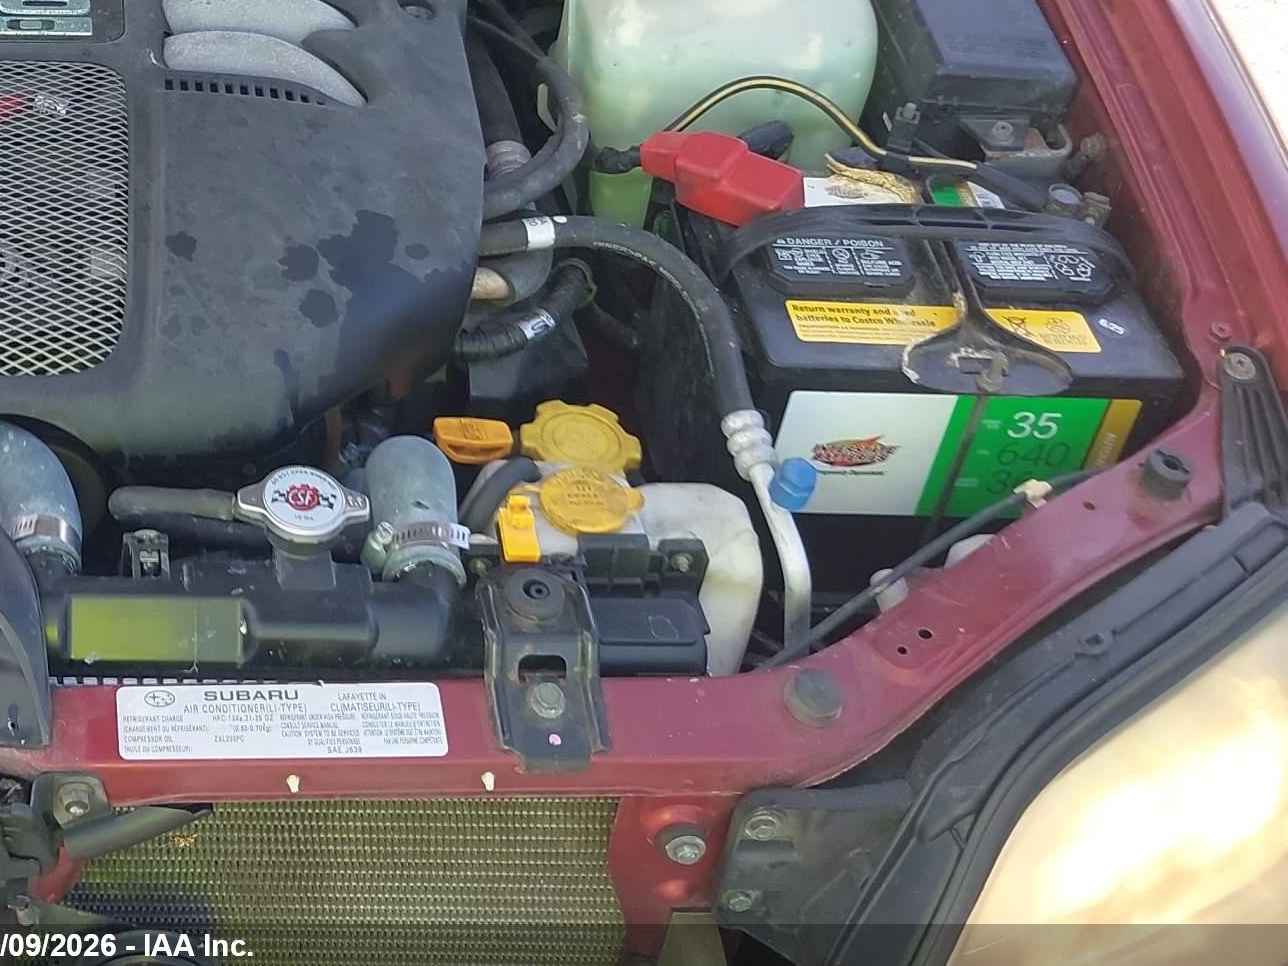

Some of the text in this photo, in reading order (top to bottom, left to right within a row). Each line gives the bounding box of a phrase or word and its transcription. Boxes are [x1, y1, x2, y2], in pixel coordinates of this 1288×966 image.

[787, 237, 831, 246] DANGER
[844, 239, 884, 247] POISON
[792, 304, 825, 312] Return
[828, 306, 870, 316] warranty
[873, 308, 890, 316] and
[796, 314, 838, 323] batteries
[853, 316, 884, 324] Costco
[1007, 410, 1063, 439] 35
[995, 442, 1071, 467] 640
[289, 490, 313, 506] CSF
[204, 689, 299, 701] SUBARU
[338, 693, 377, 701] LAFAYETTE
[184, 705, 198, 713] AIR
